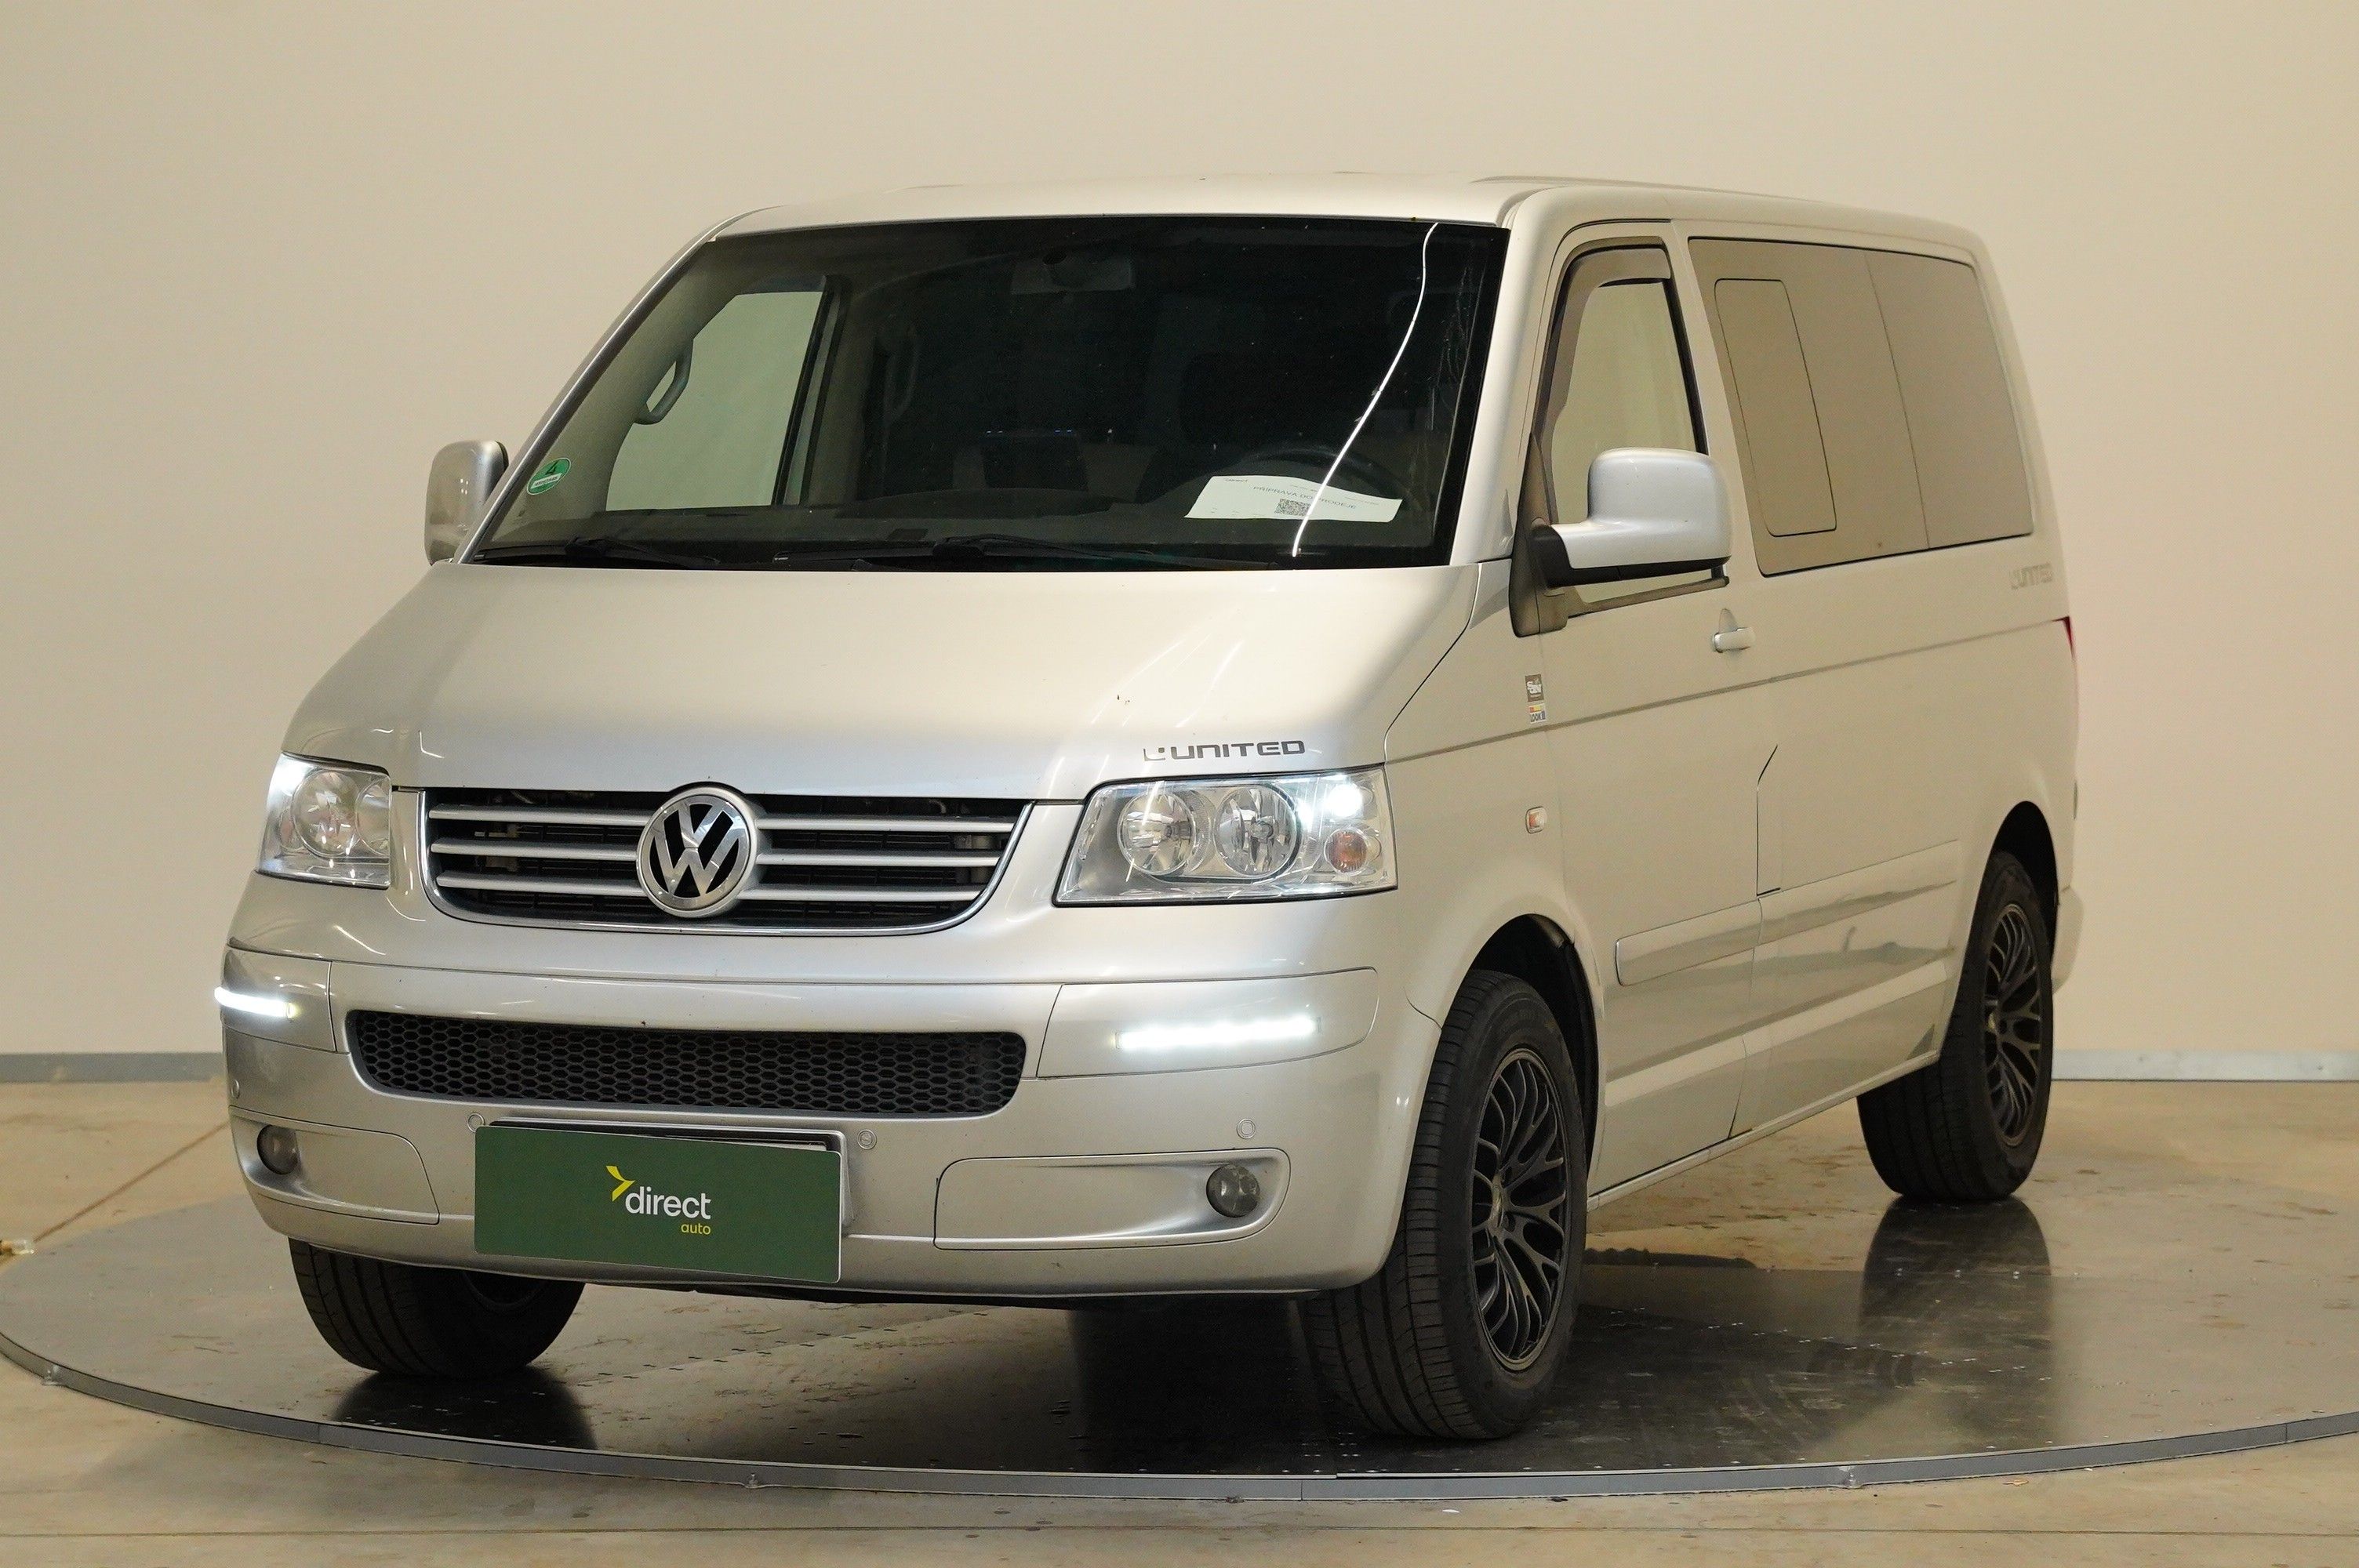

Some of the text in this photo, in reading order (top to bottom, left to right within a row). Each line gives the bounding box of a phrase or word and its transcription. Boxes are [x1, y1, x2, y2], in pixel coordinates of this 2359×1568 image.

[545, 460, 558, 475] 4
[1170, 739, 1306, 760] UNITED
[624, 1185, 711, 1220] direct
[680, 1222, 711, 1236] auto
